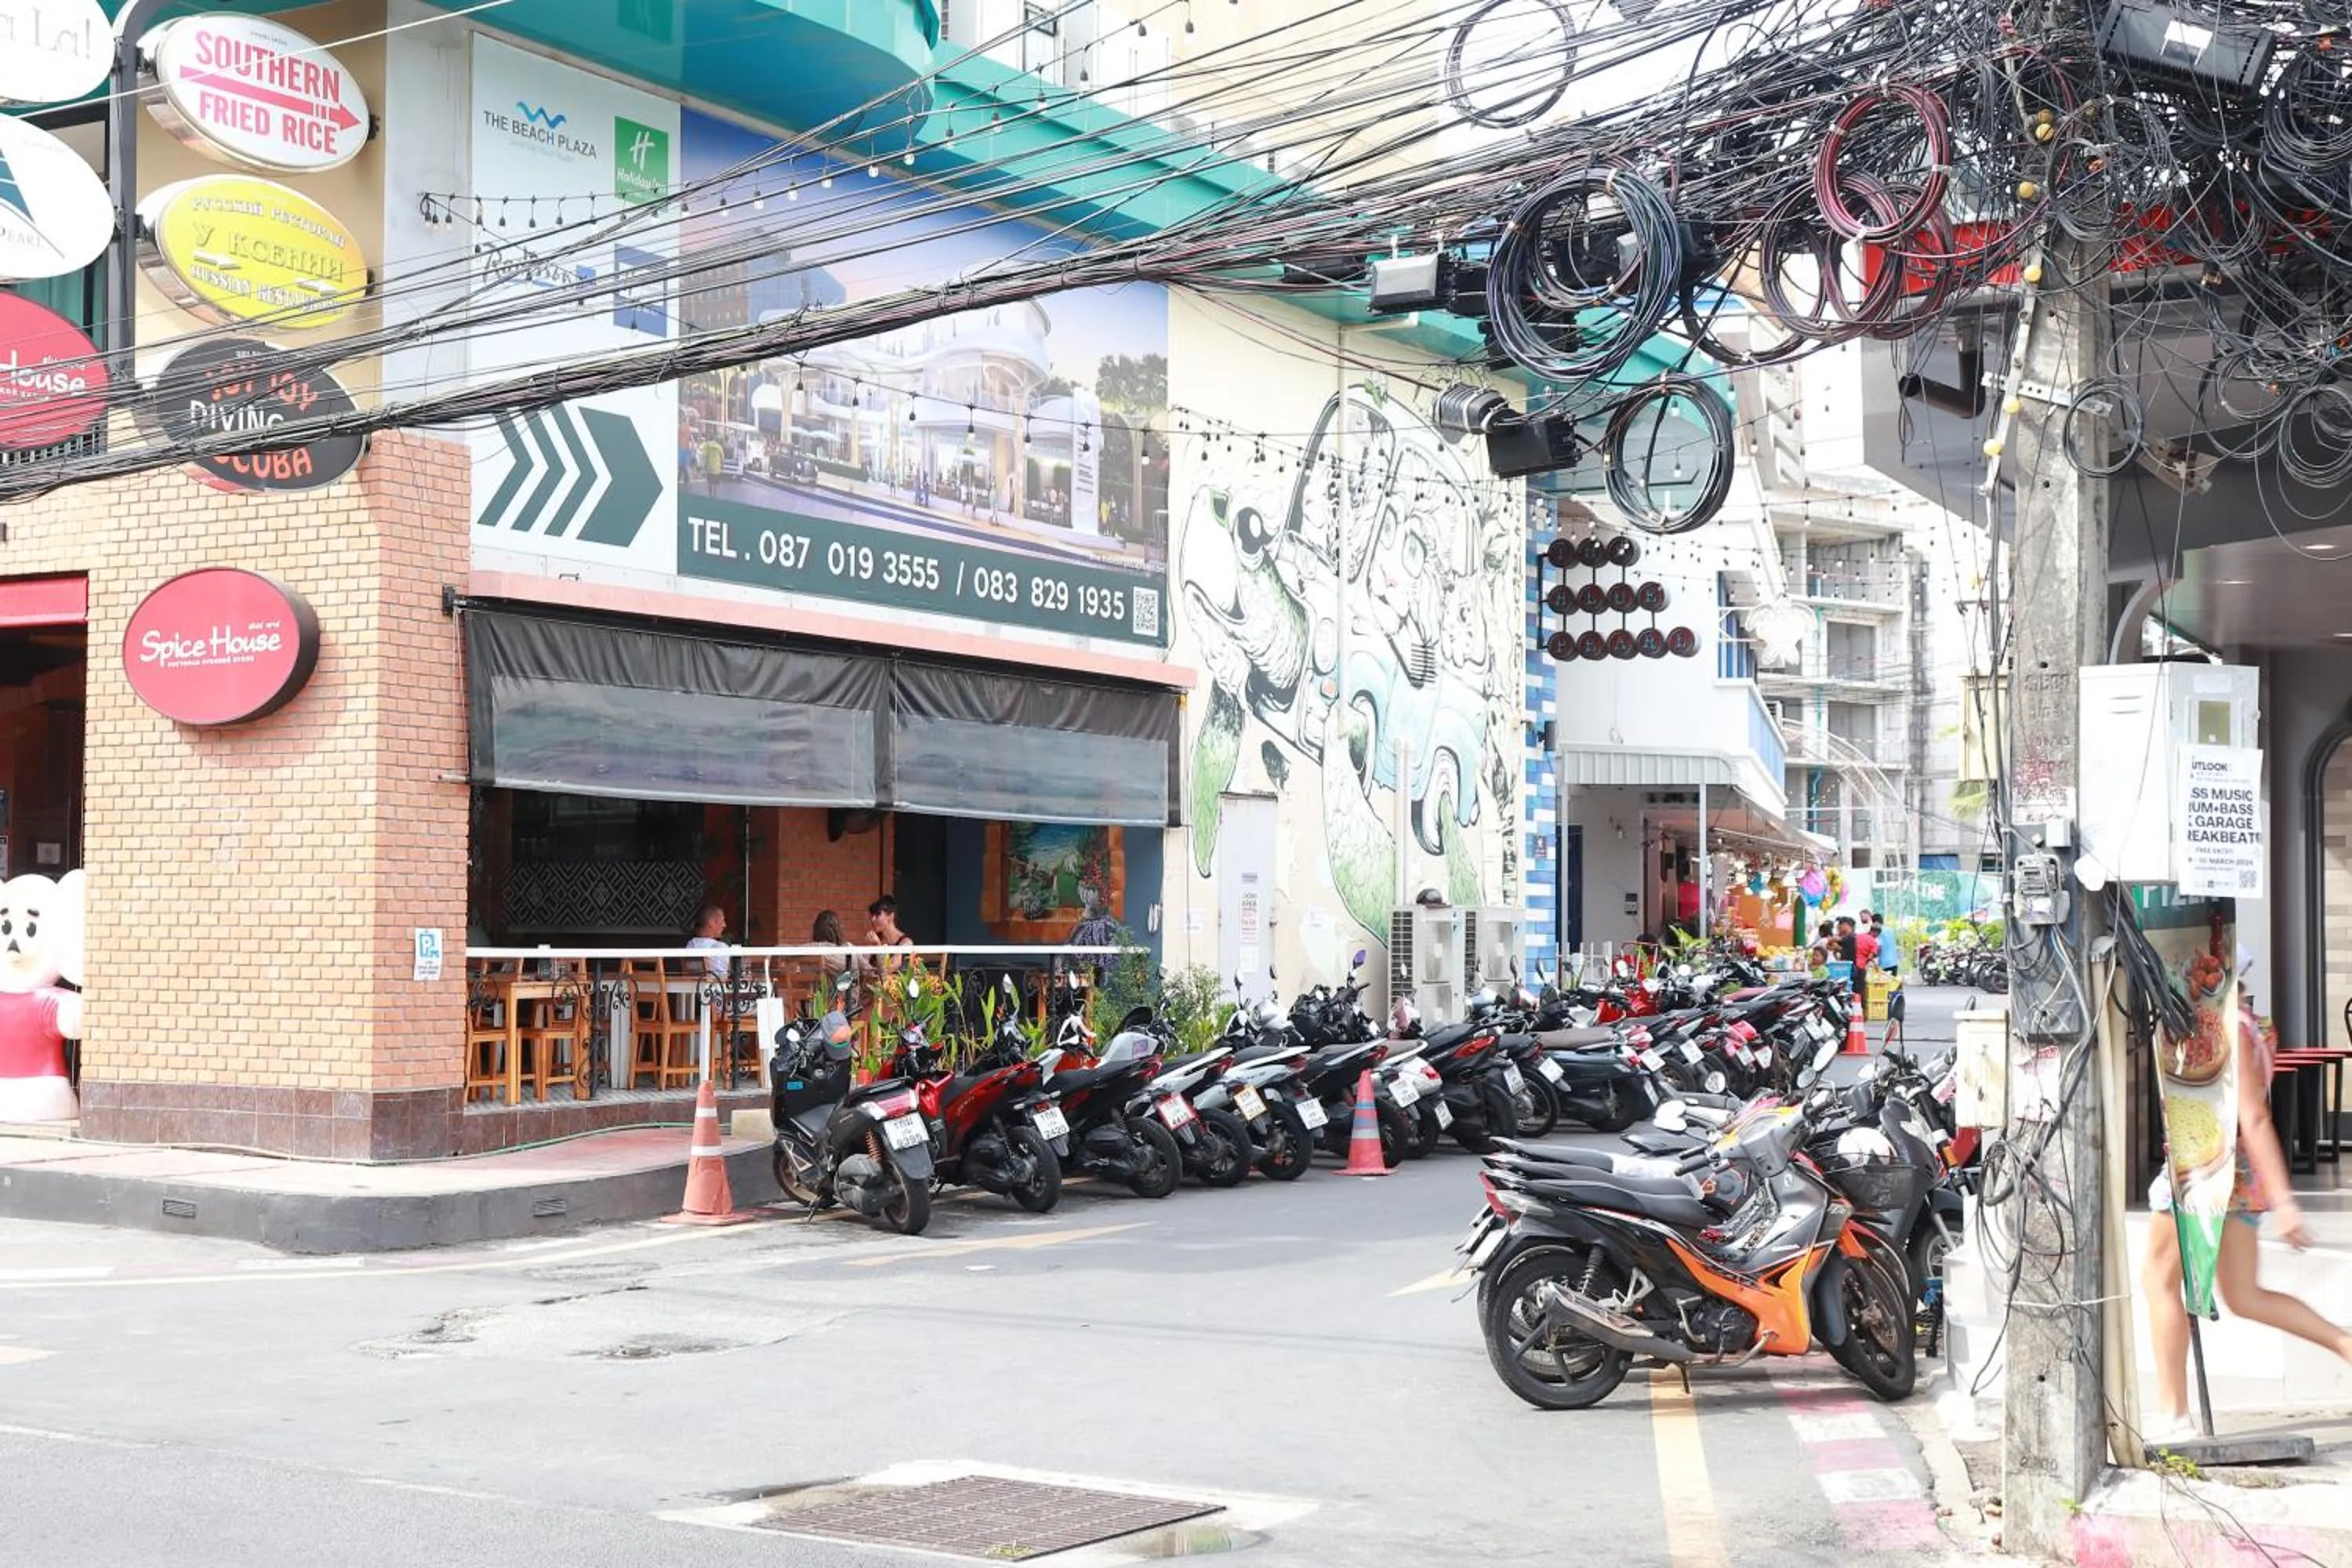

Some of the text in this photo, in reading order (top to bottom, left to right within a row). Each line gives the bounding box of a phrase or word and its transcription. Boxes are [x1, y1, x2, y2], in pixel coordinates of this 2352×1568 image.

[195, 31, 339, 103] SOUTHERN
[199, 90, 338, 154] FRIED RICE
[484, 110, 509, 132] THE
[512, 119, 555, 146] BEACH
[557, 134, 597, 159] PLAZA
[758, 528, 811, 569] 087
[827, 541, 873, 580] 019
[882, 550, 939, 590] 3555
[974, 566, 1018, 603] 083
[1030, 576, 1069, 612] 829
[1077, 585, 1125, 620] 1935
[140, 624, 282, 667] Spice House
[2191, 761, 2228, 771] UTLOOK
[2189, 801, 2254, 816] UM+BASS
[2212, 788, 2253, 802] MUSIC
[2188, 829, 2260, 844] EAKBEAT
[2195, 815, 2253, 829] GARAGE
